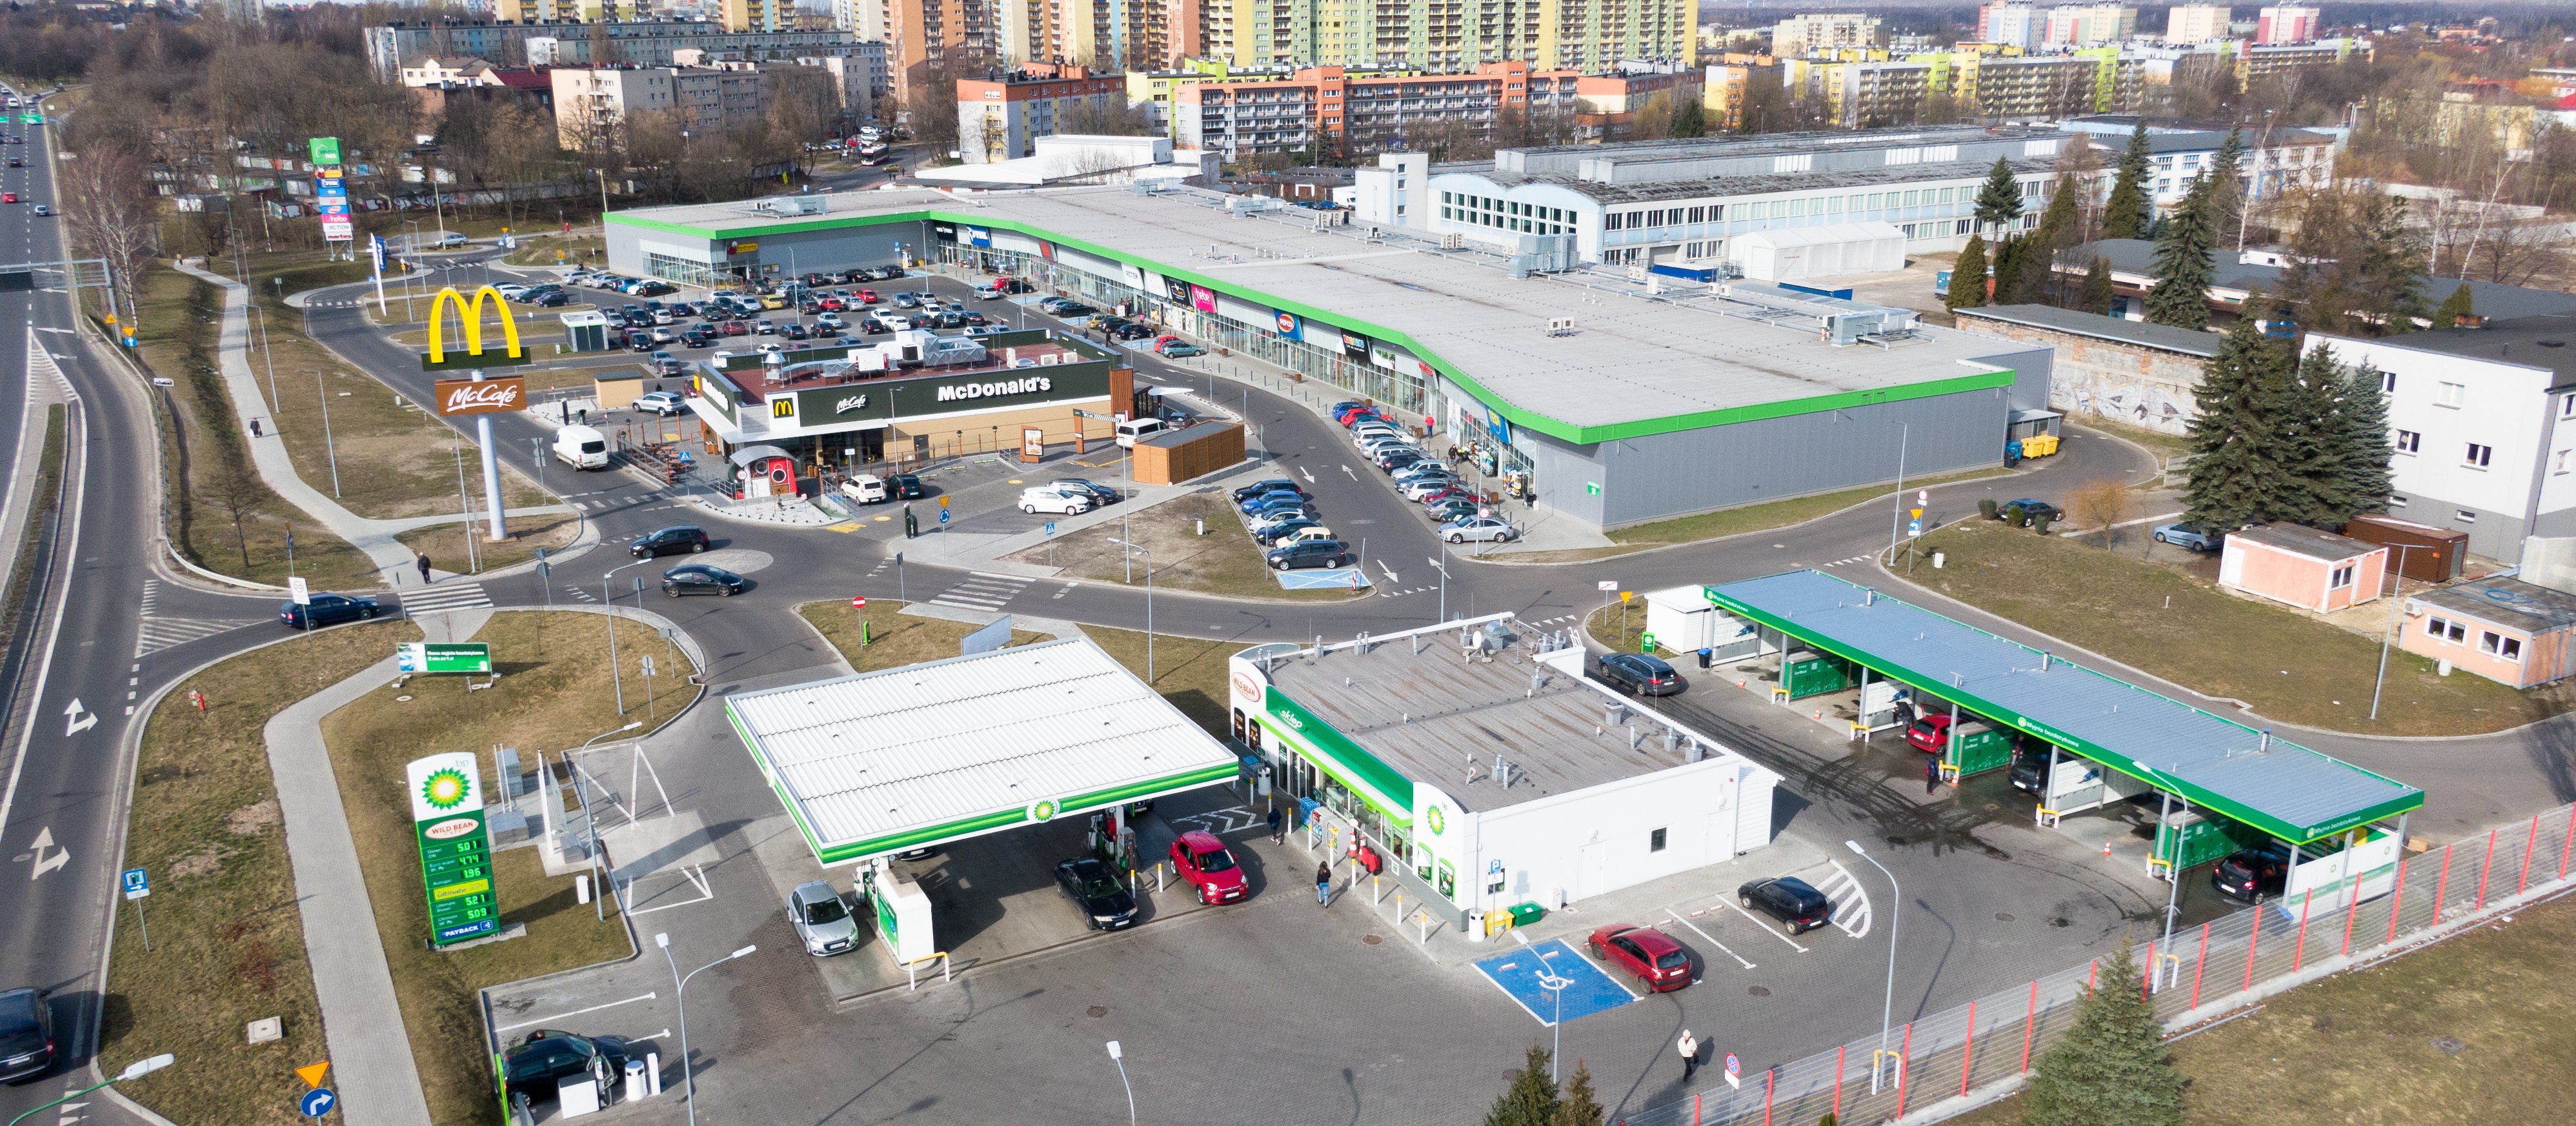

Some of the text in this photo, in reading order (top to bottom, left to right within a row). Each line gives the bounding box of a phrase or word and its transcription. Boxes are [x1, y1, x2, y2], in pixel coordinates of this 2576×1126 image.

[972, 230, 989, 240] JYSK
[1196, 287, 1211, 302] hebe
[1279, 318, 1294, 328] PEPCO
[938, 377, 1051, 401] McDonald's
[447, 384, 518, 412] McCafé
[1233, 678, 1243, 689] WILD
[1243, 683, 1255, 697] BEAN
[1281, 709, 1303, 729] sklep
[456, 759, 470, 767] bp
[431, 821, 474, 834] WILD BEAN
[445, 925, 479, 937] PAYBACK
